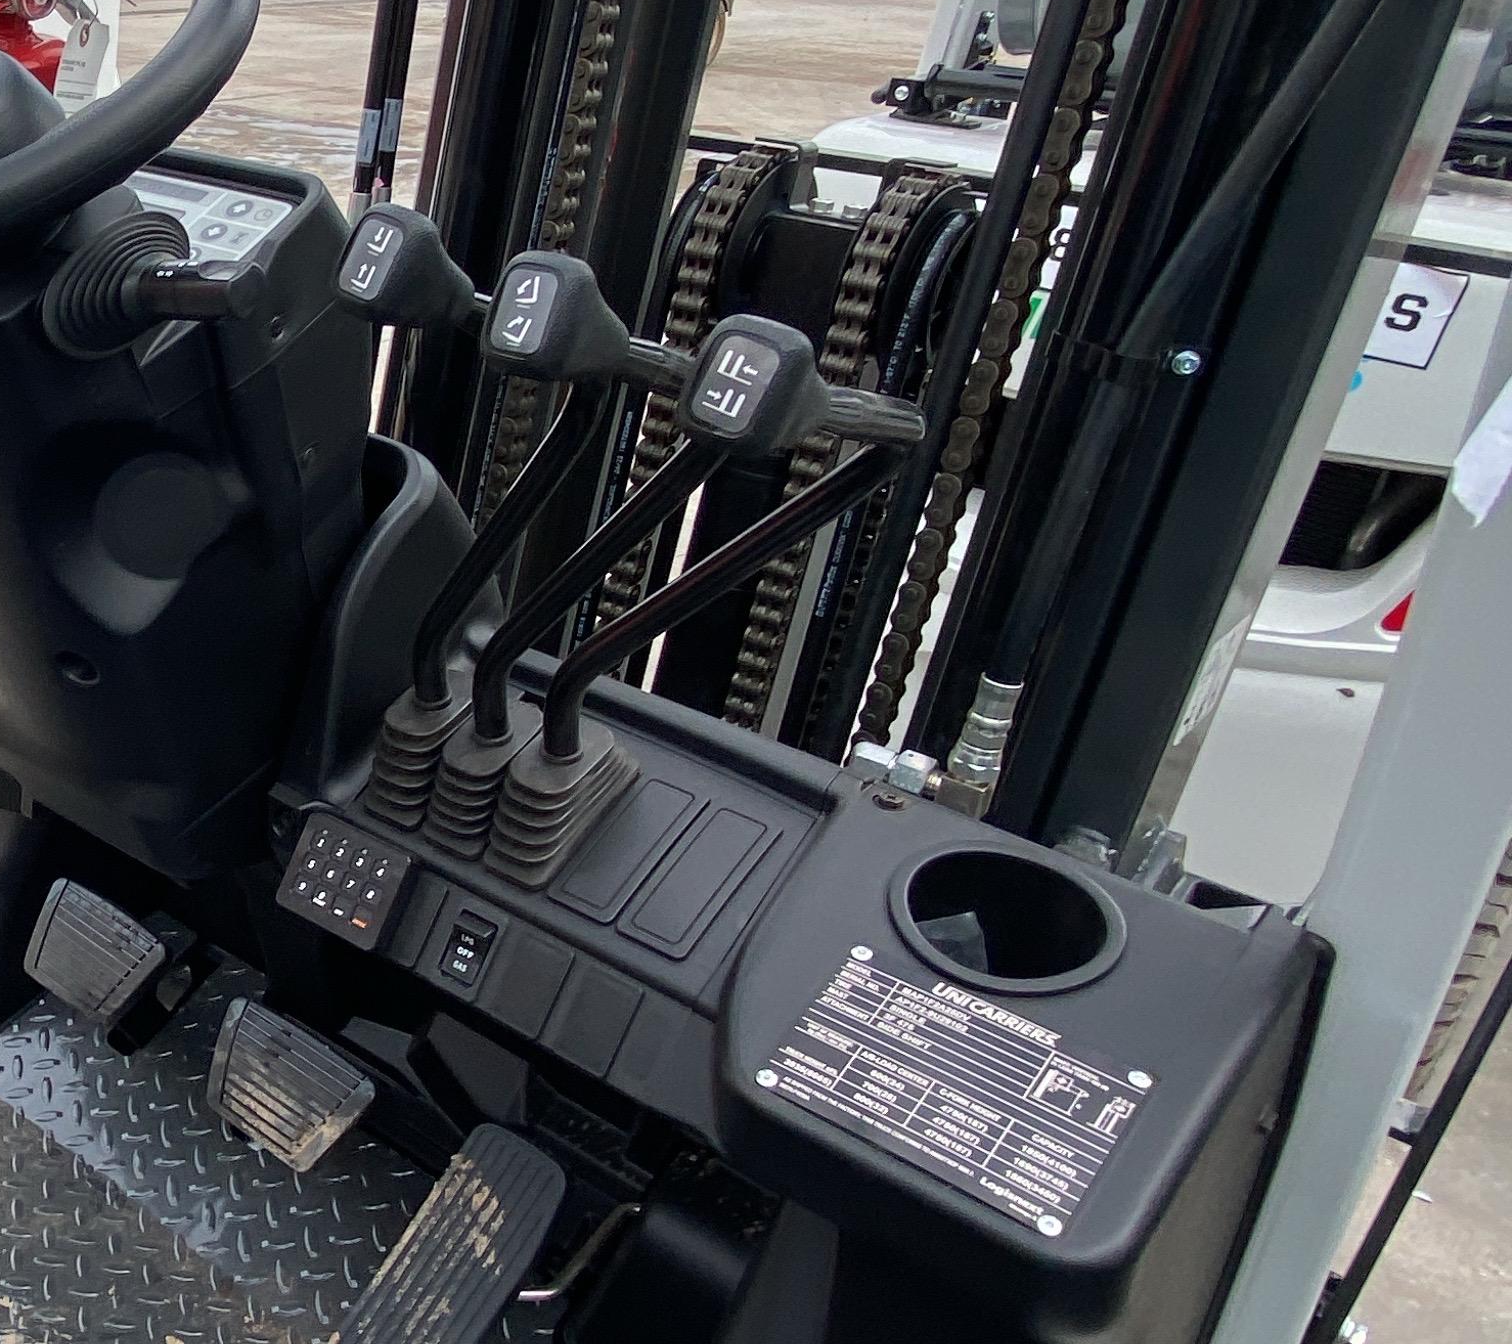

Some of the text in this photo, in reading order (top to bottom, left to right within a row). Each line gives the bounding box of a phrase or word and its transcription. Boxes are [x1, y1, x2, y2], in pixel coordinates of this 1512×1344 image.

[317, 837, 384, 877] 1 2 3 4
[298, 881, 306, 891] 9
[307, 859, 374, 899] 5 6 7 8
[457, 946, 472, 958] OFF
[453, 960, 466, 971] GAS
[844, 961, 873, 977] MODEL
[819, 994, 931, 1051] ATTACHMENT SIDE SHIFT
[929, 980, 1063, 1048] UNICARRIERS
[1029, 1133, 1075, 1159] CAPACITY
